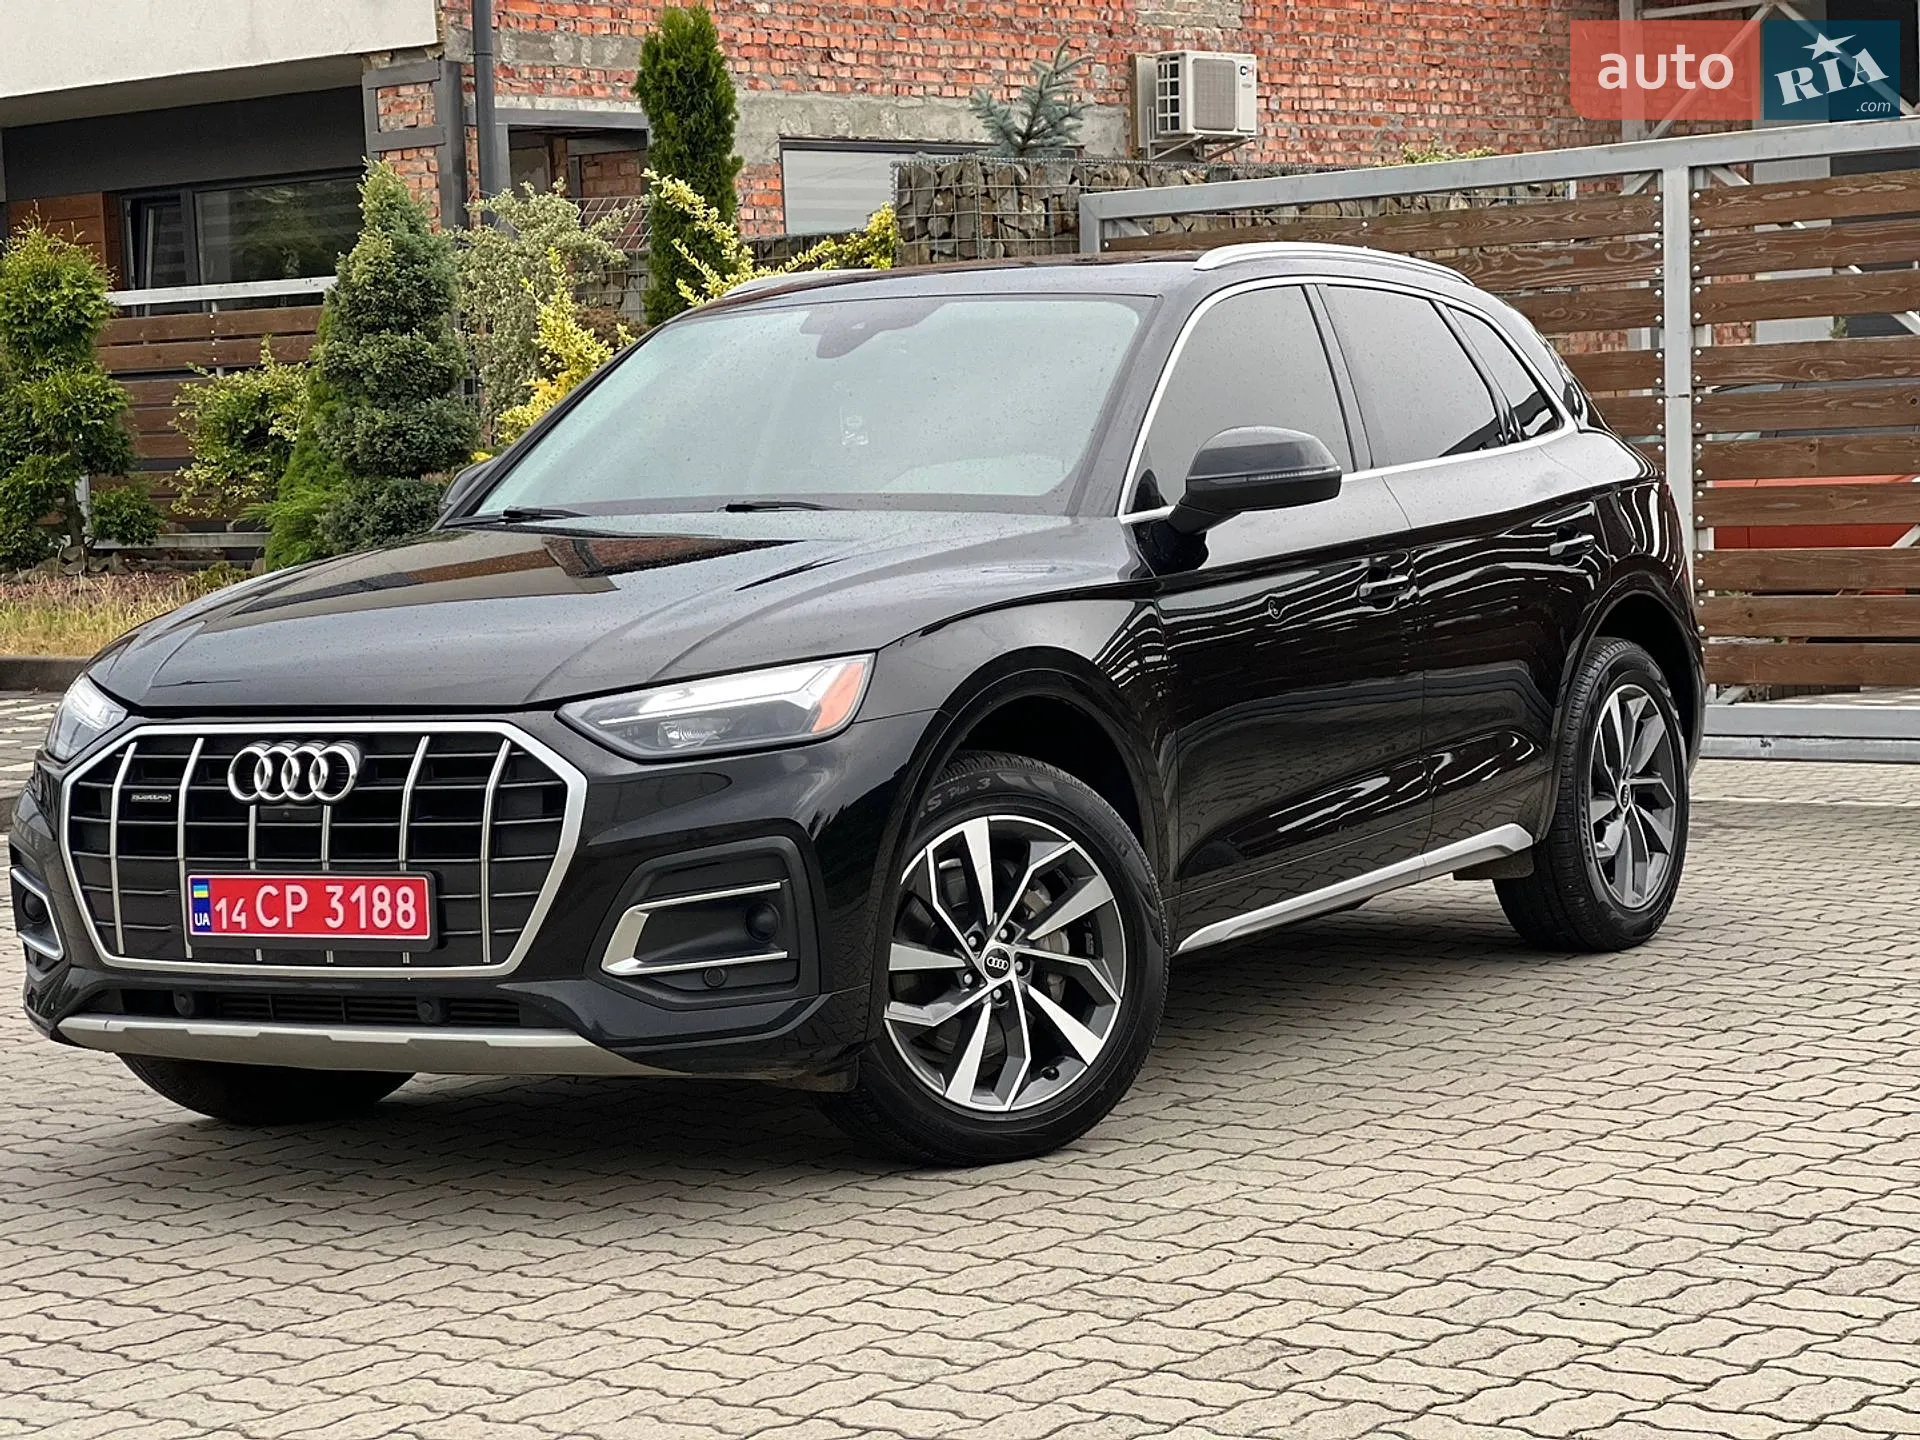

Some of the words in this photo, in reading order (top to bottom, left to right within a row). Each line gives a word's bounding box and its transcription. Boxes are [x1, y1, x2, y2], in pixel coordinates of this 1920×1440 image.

[977, 778, 991, 790] 3
[214, 897, 247, 930] 14
[255, 885, 309, 929] CP
[324, 885, 417, 930] 3188
[194, 912, 211, 927] UA
